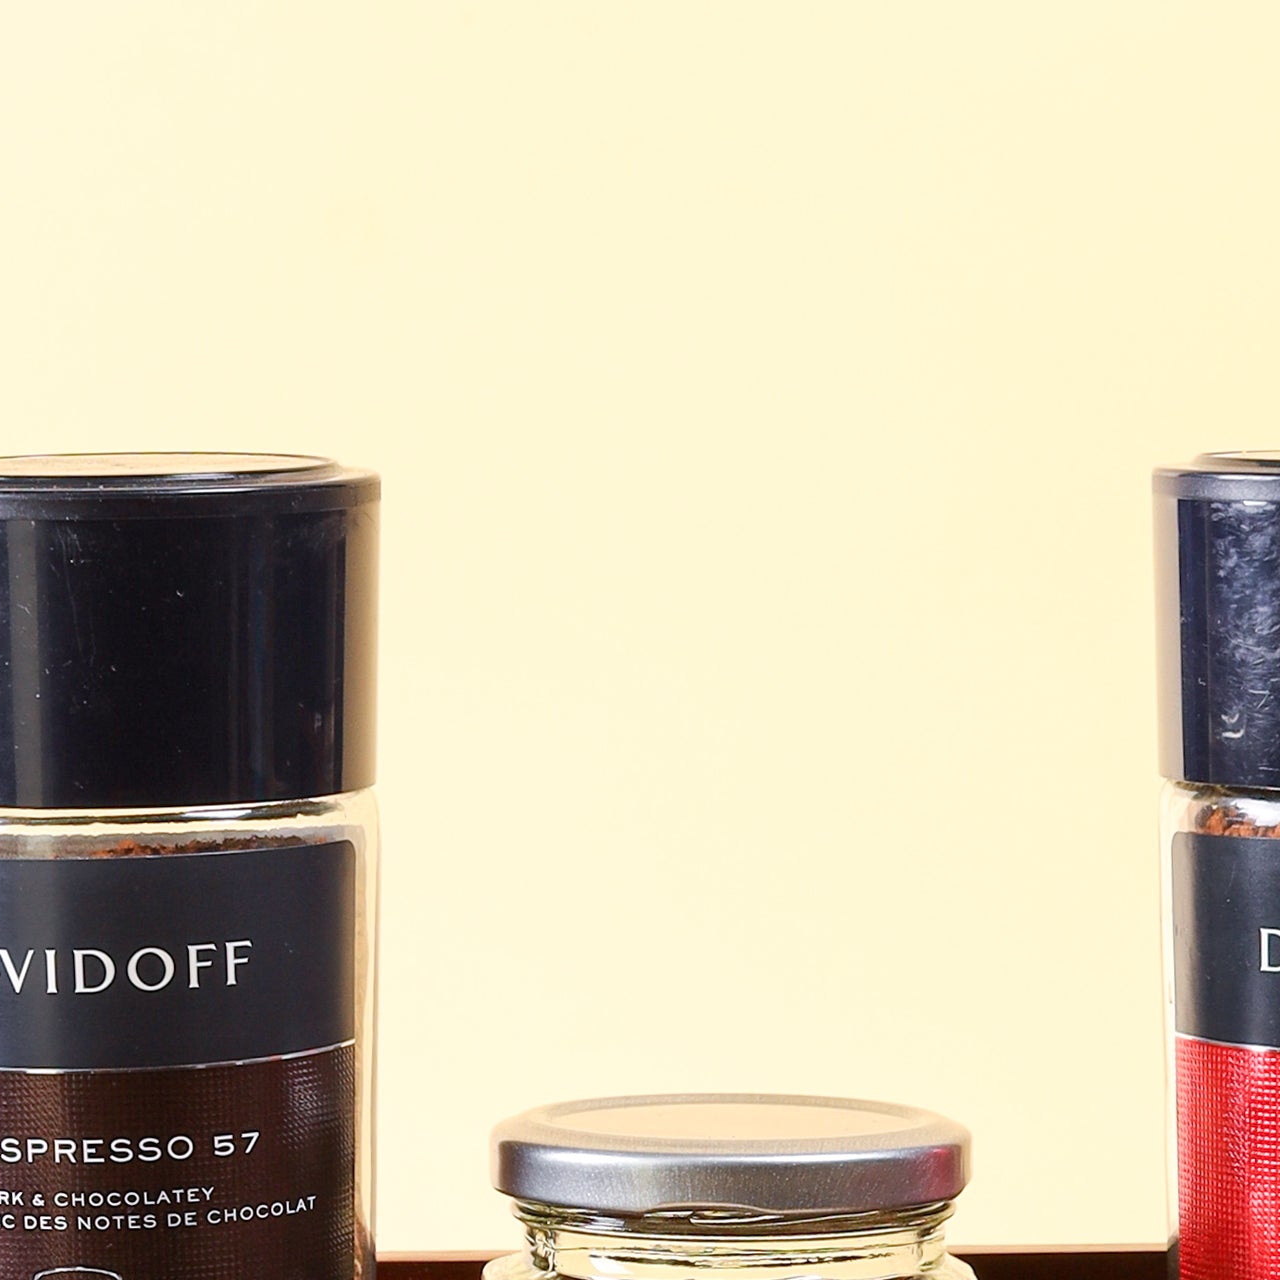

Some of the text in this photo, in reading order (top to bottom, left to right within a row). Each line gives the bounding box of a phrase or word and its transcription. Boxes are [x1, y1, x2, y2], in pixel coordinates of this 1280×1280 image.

[213, 1131, 261, 1156] 57
[32, 1192, 45, 1207] &
[53, 1185, 216, 1208] CHOCOLATEY
[23, 1212, 68, 1231] DES
[77, 1210, 158, 1231] NOTES
[166, 1208, 198, 1227] DE
[206, 1194, 318, 1225] CHOCOLAT
